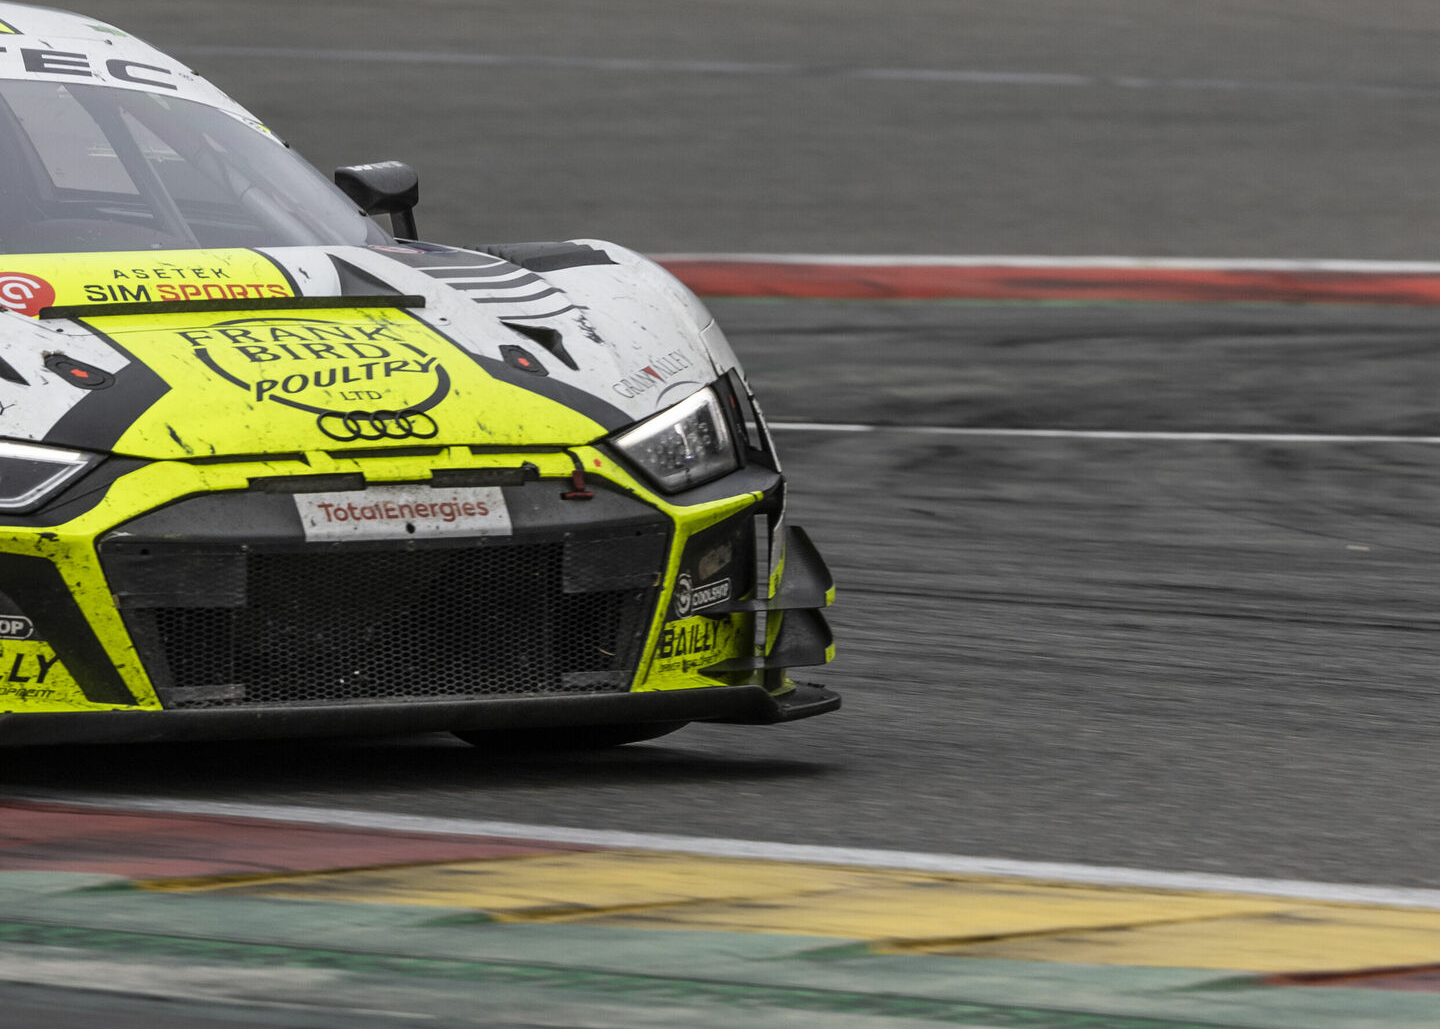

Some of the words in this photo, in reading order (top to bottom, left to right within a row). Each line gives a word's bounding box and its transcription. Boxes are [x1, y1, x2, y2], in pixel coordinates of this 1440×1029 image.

[113, 268, 231, 280] ASETEK
[84, 284, 152, 302] SIM
[156, 283, 290, 302] SPORTS
[177, 325, 401, 347] FRANK
[237, 342, 391, 363] BIRD
[256, 357, 440, 402] POULTRY
[340, 390, 383, 401] LTD
[318, 497, 490, 523] TotalEnergies
[660, 621, 719, 659] BAILLY
